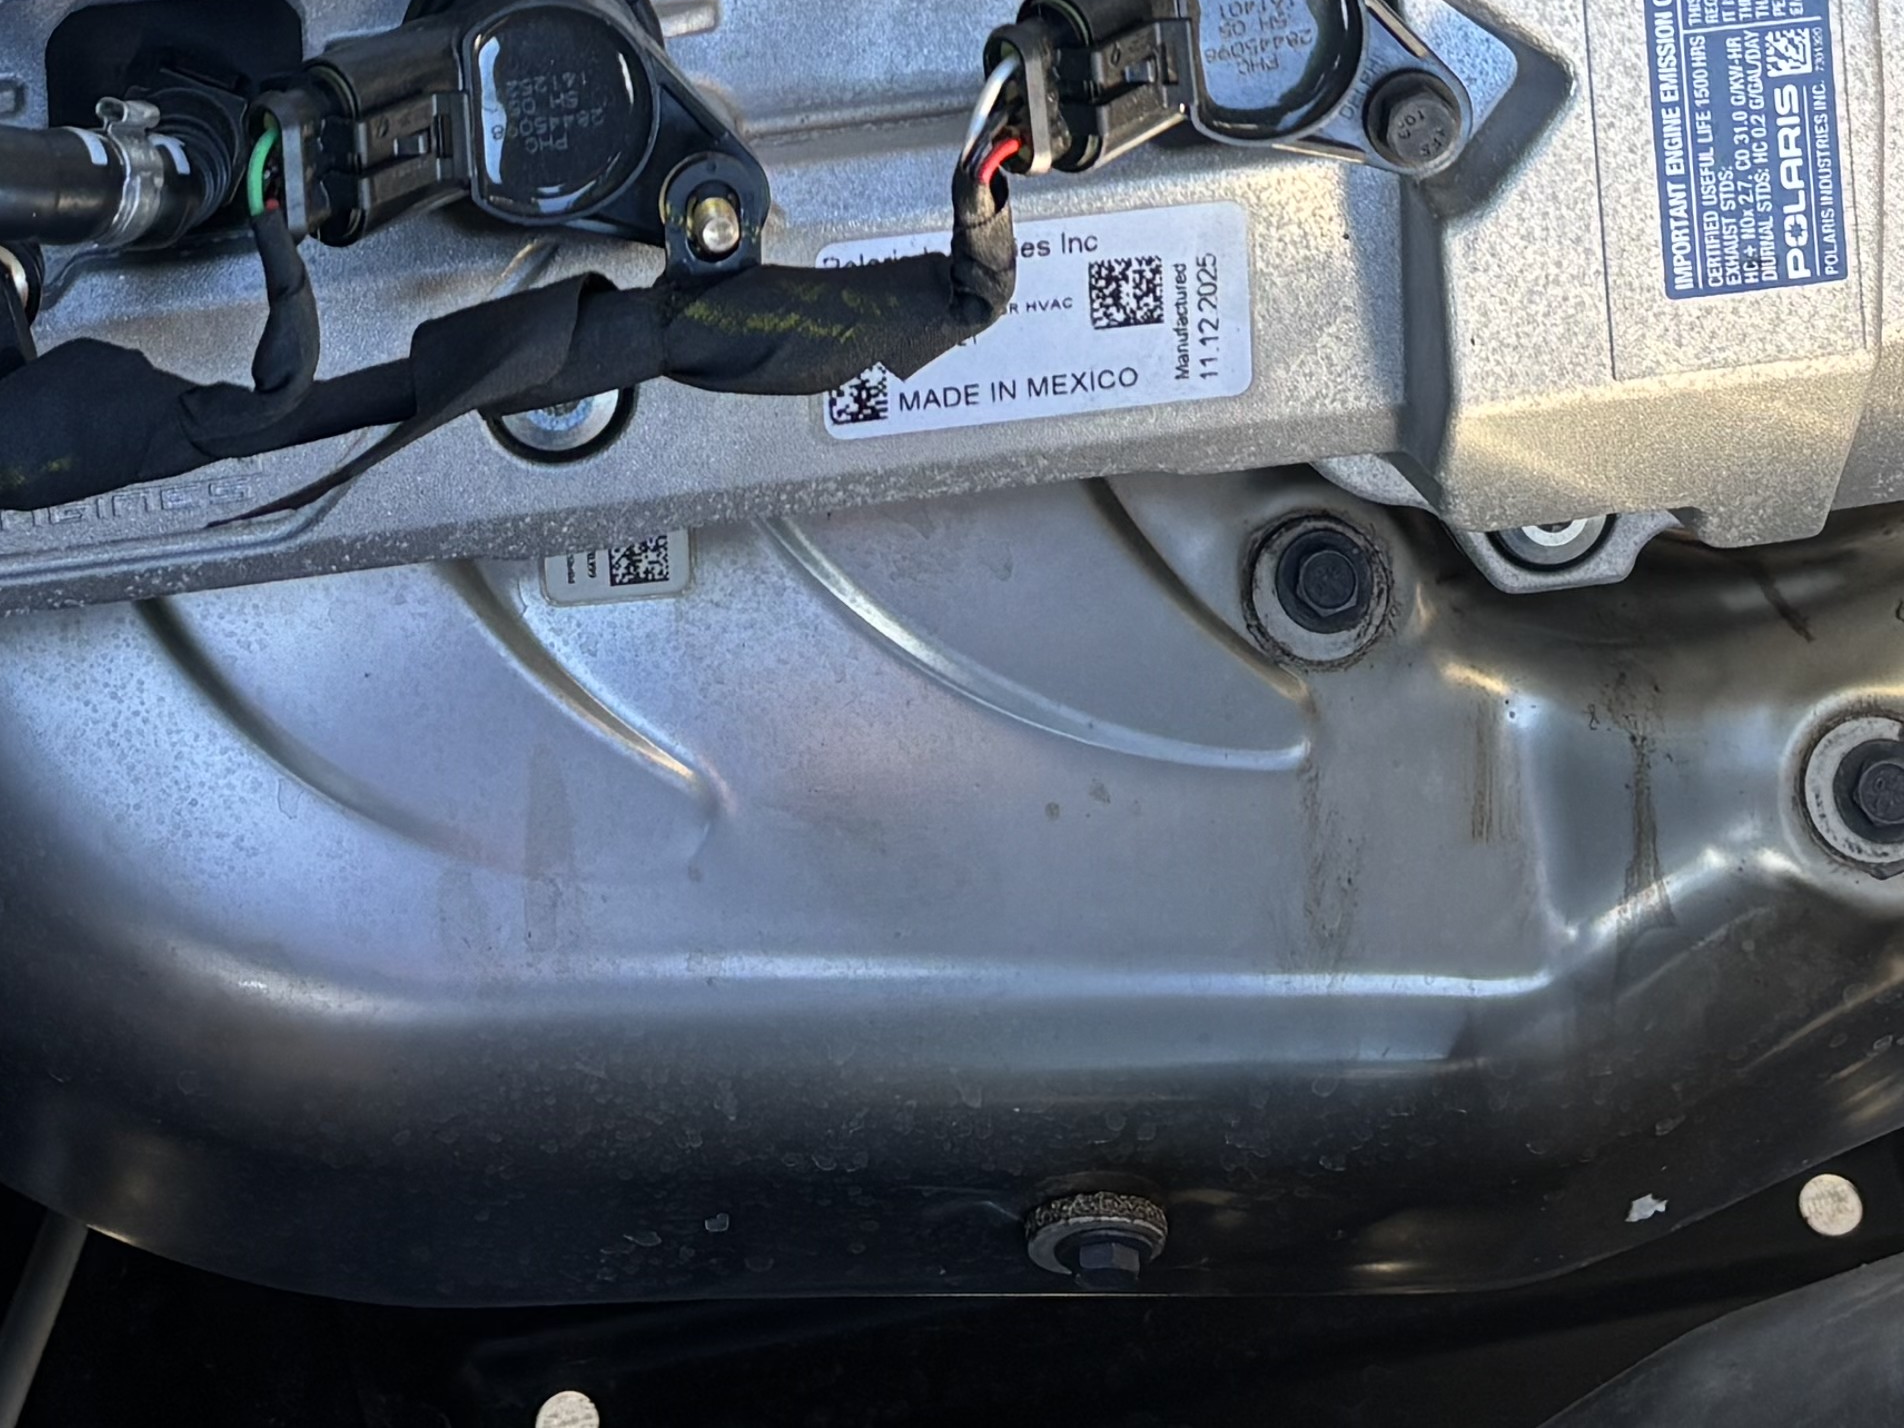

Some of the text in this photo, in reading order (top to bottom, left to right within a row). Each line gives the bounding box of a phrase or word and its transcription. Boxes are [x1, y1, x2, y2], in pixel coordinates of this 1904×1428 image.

[1721, 9, 1736, 22] IT
[1654, 10, 1679, 102] EMISSION
[1726, 36, 1747, 105] G/KW-HR
[1661, 106, 1685, 175] ENGINE
[1689, 35, 1723, 287] CERTIFIED USEFUL LIFE 1500 HRS
[1732, 110, 1749, 144] 31.0
[1734, 148, 1751, 170] CO
[1744, 28, 1777, 281] DIURNAL STDS: HC 0.2 G/GAL/DAY
[1773, 83, 1811, 278] POLARIS
[1811, 80, 1839, 274] POLARIS INDUSTRIES INC.
[1061, 232, 1099, 255] Inc
[1667, 179, 1693, 290] IMPORTANT
[1717, 165, 1741, 285] EXHAUST STDS:
[1739, 208, 1756, 239] NOx
[1025, 296, 1074, 313] HVAC
[1743, 260, 1760, 283] HC
[1175, 263, 1189, 381] Manufactured
[899, 367, 1139, 413] MADE IN MEXICO
